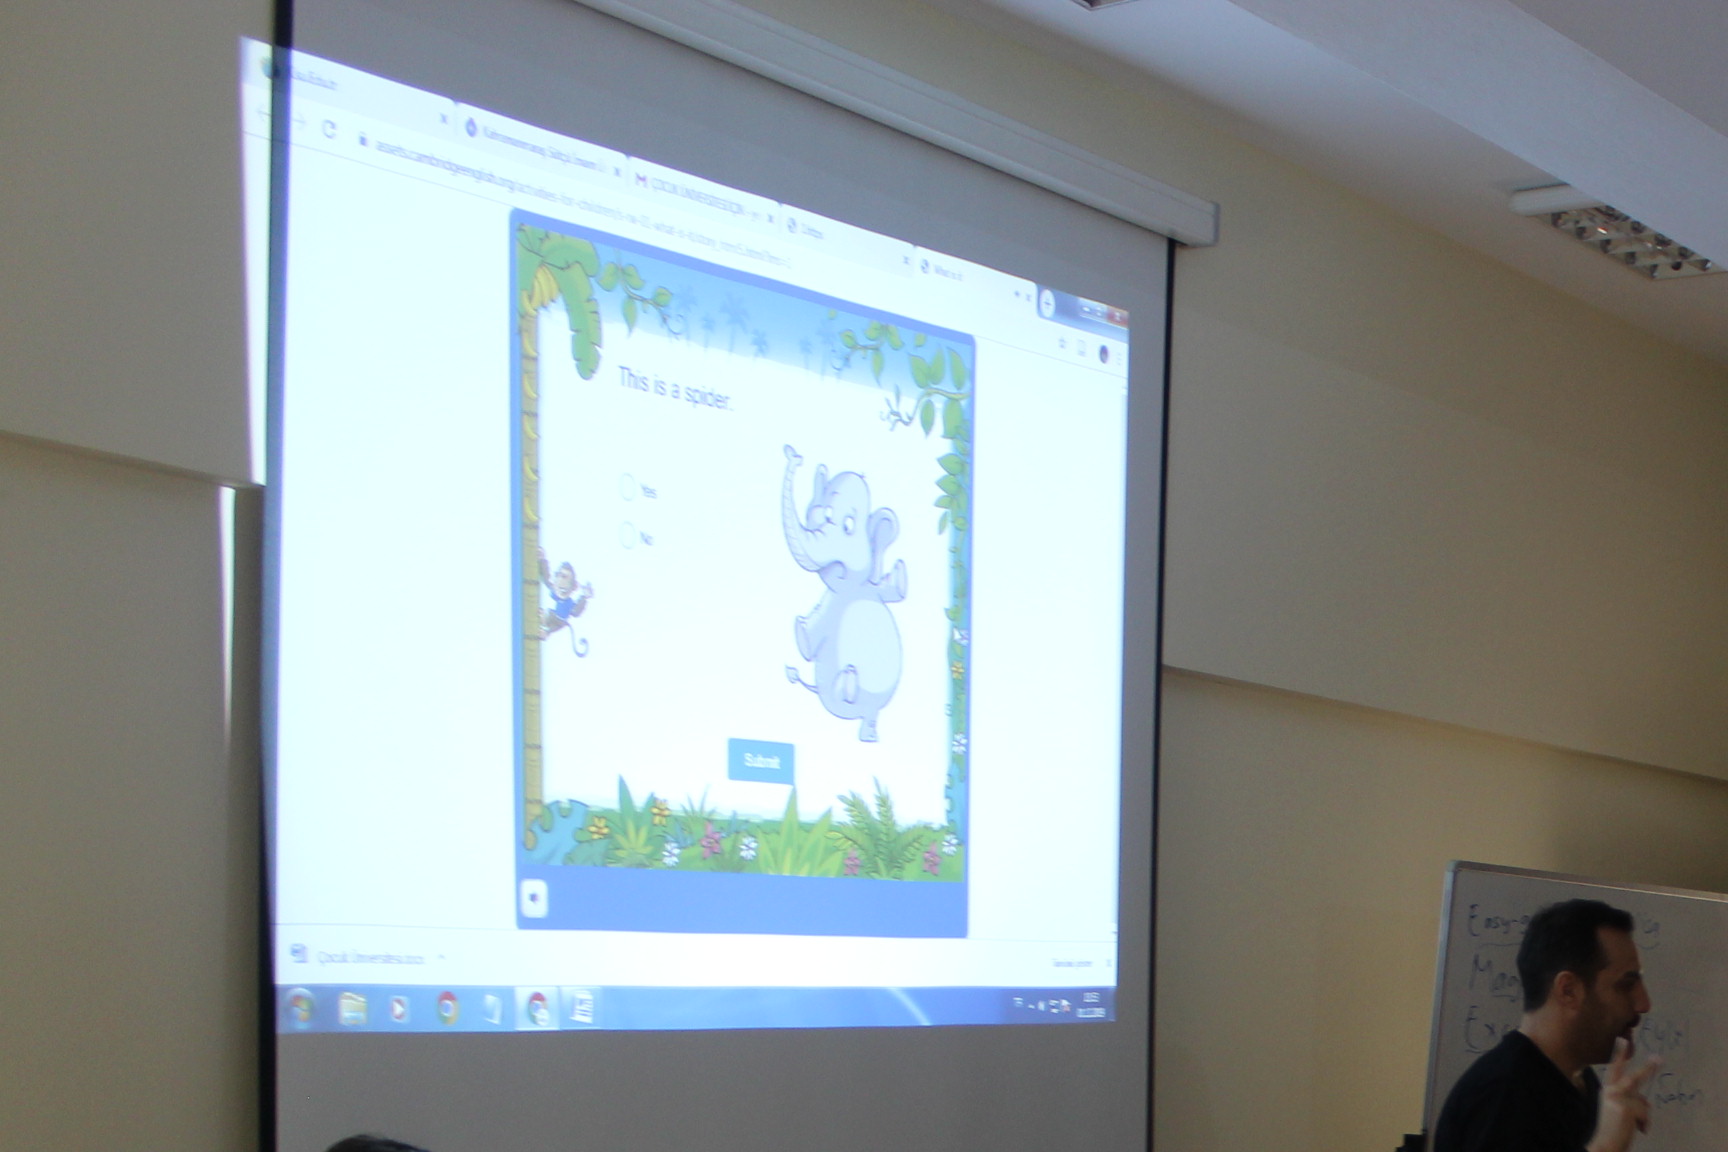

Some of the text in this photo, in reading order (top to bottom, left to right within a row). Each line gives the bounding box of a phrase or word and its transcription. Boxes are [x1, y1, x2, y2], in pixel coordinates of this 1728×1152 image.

[618, 365, 650, 392] This
[654, 374, 667, 396] is
[671, 383, 681, 400] a
[640, 483, 658, 500] Yes
[744, 752, 781, 769] Submit
